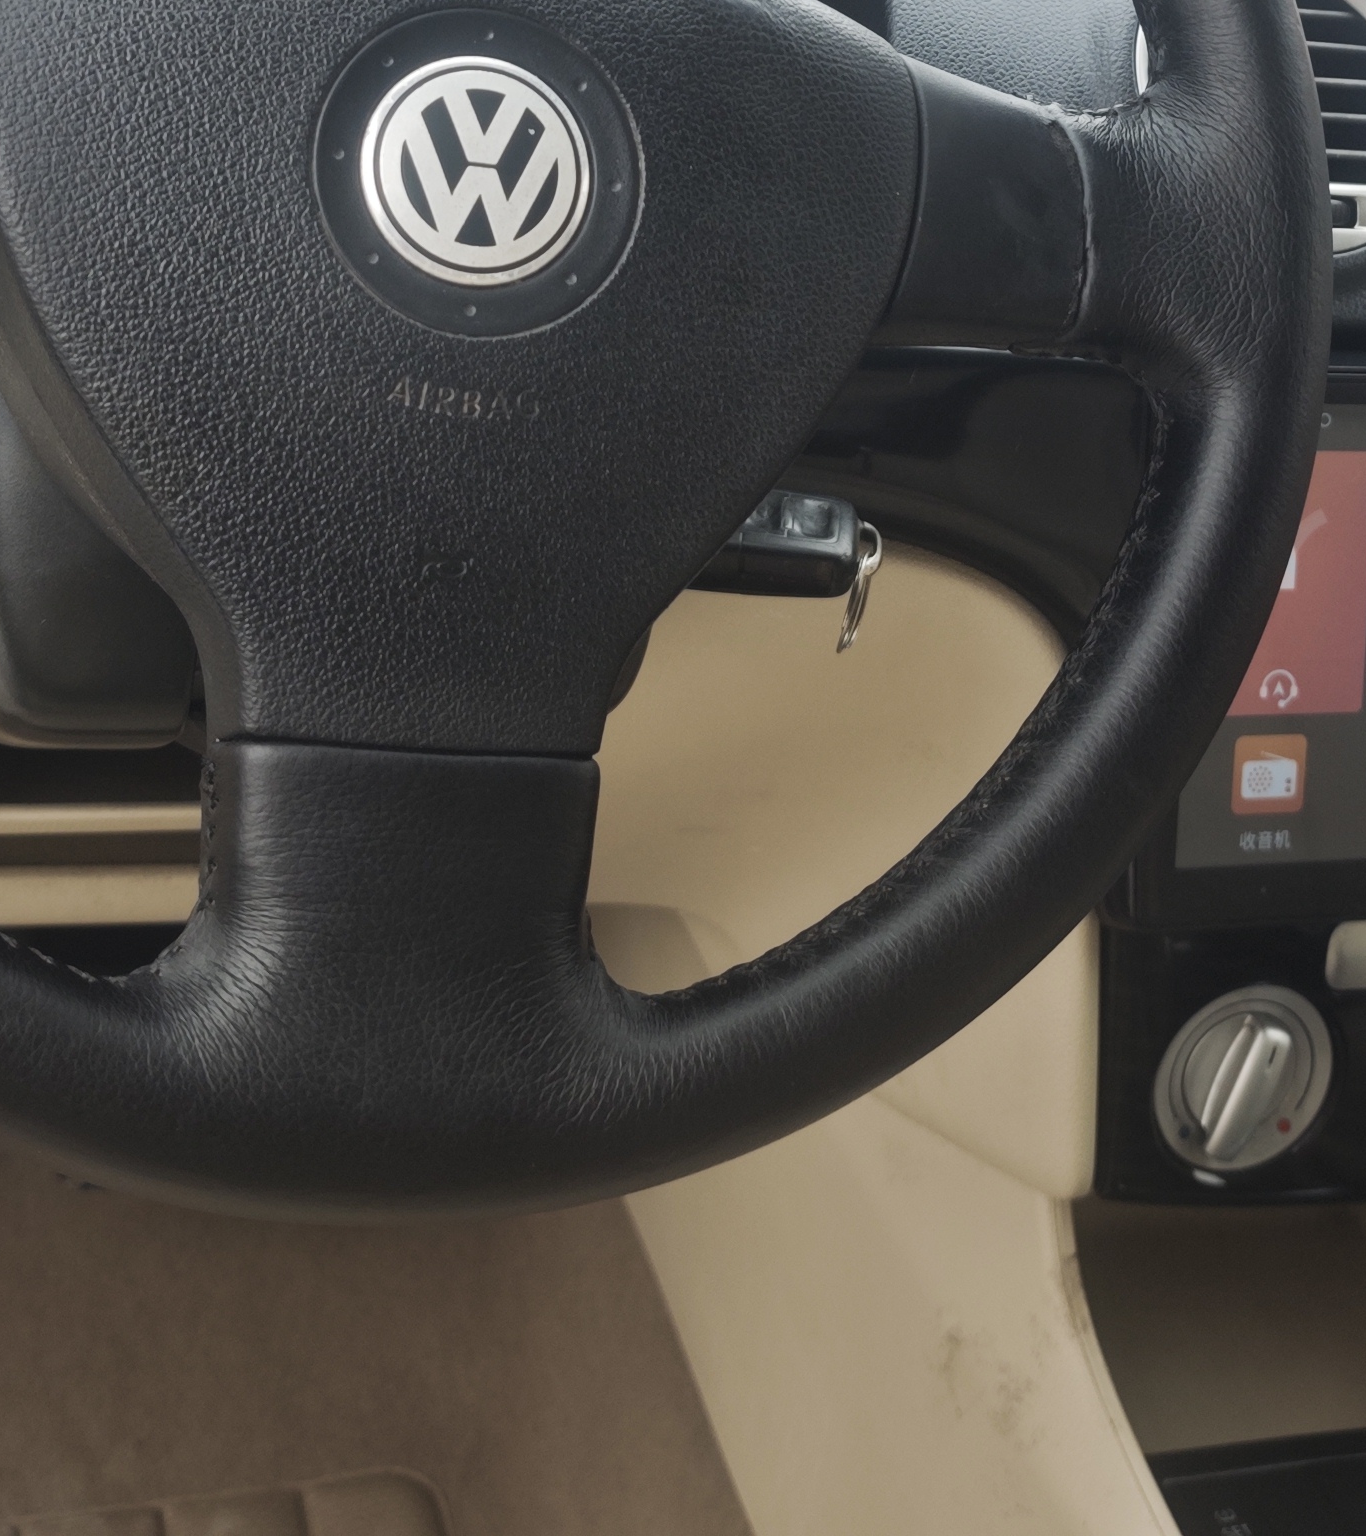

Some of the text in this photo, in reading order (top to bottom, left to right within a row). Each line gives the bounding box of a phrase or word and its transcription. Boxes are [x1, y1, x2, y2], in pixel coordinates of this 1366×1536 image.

[386, 375, 540, 419] AIRBAG
[1239, 830, 1290, 851] 收音机
